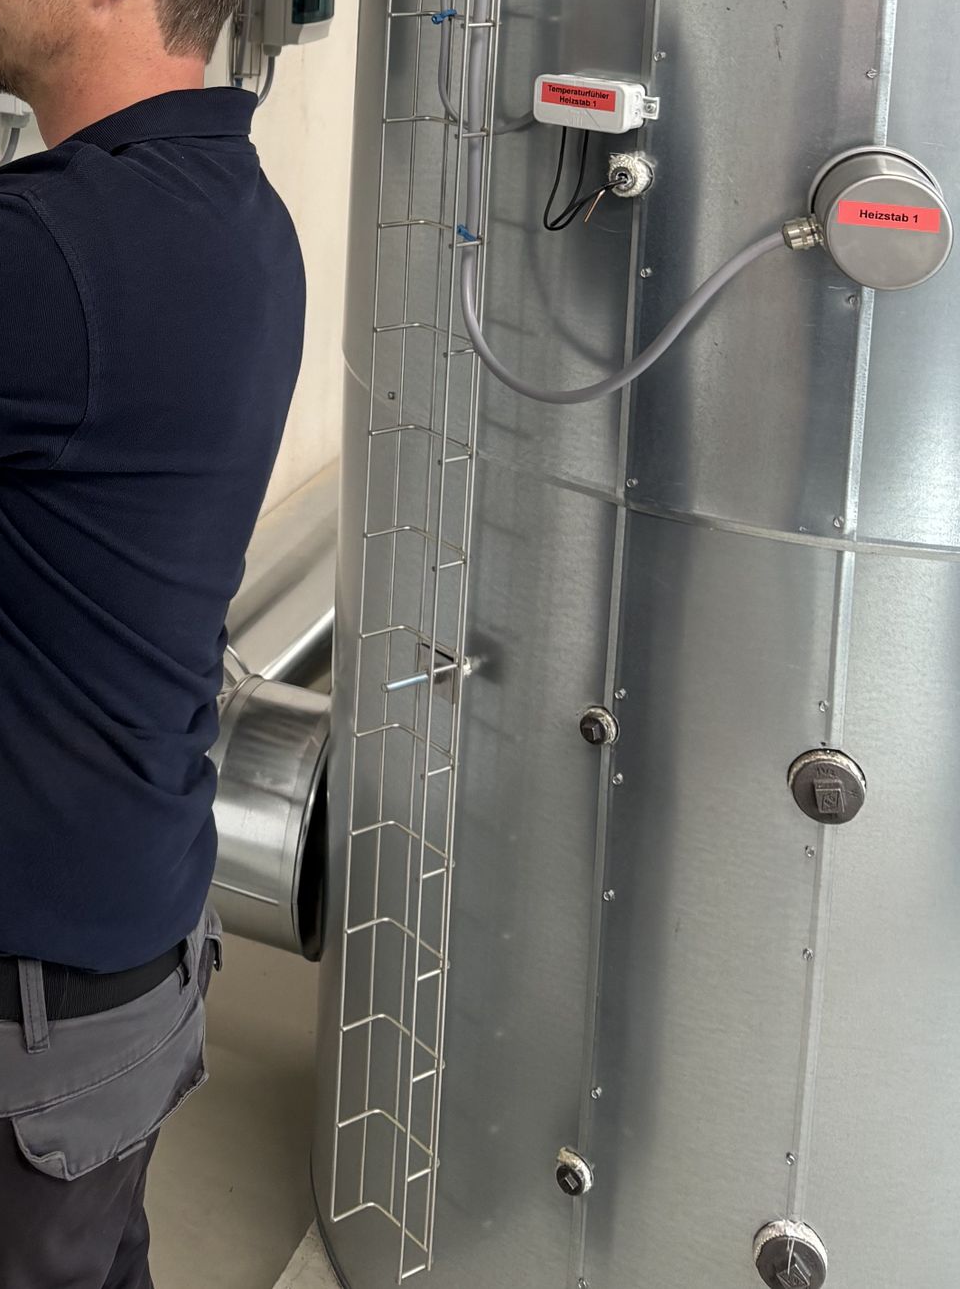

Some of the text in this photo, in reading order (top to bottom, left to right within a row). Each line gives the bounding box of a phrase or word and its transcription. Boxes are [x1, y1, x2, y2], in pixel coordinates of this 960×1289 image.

[548, 84, 609, 100] Temperaturfühler
[559, 95, 591, 107] Heizstab
[859, 209, 919, 223] Heizstab 1
